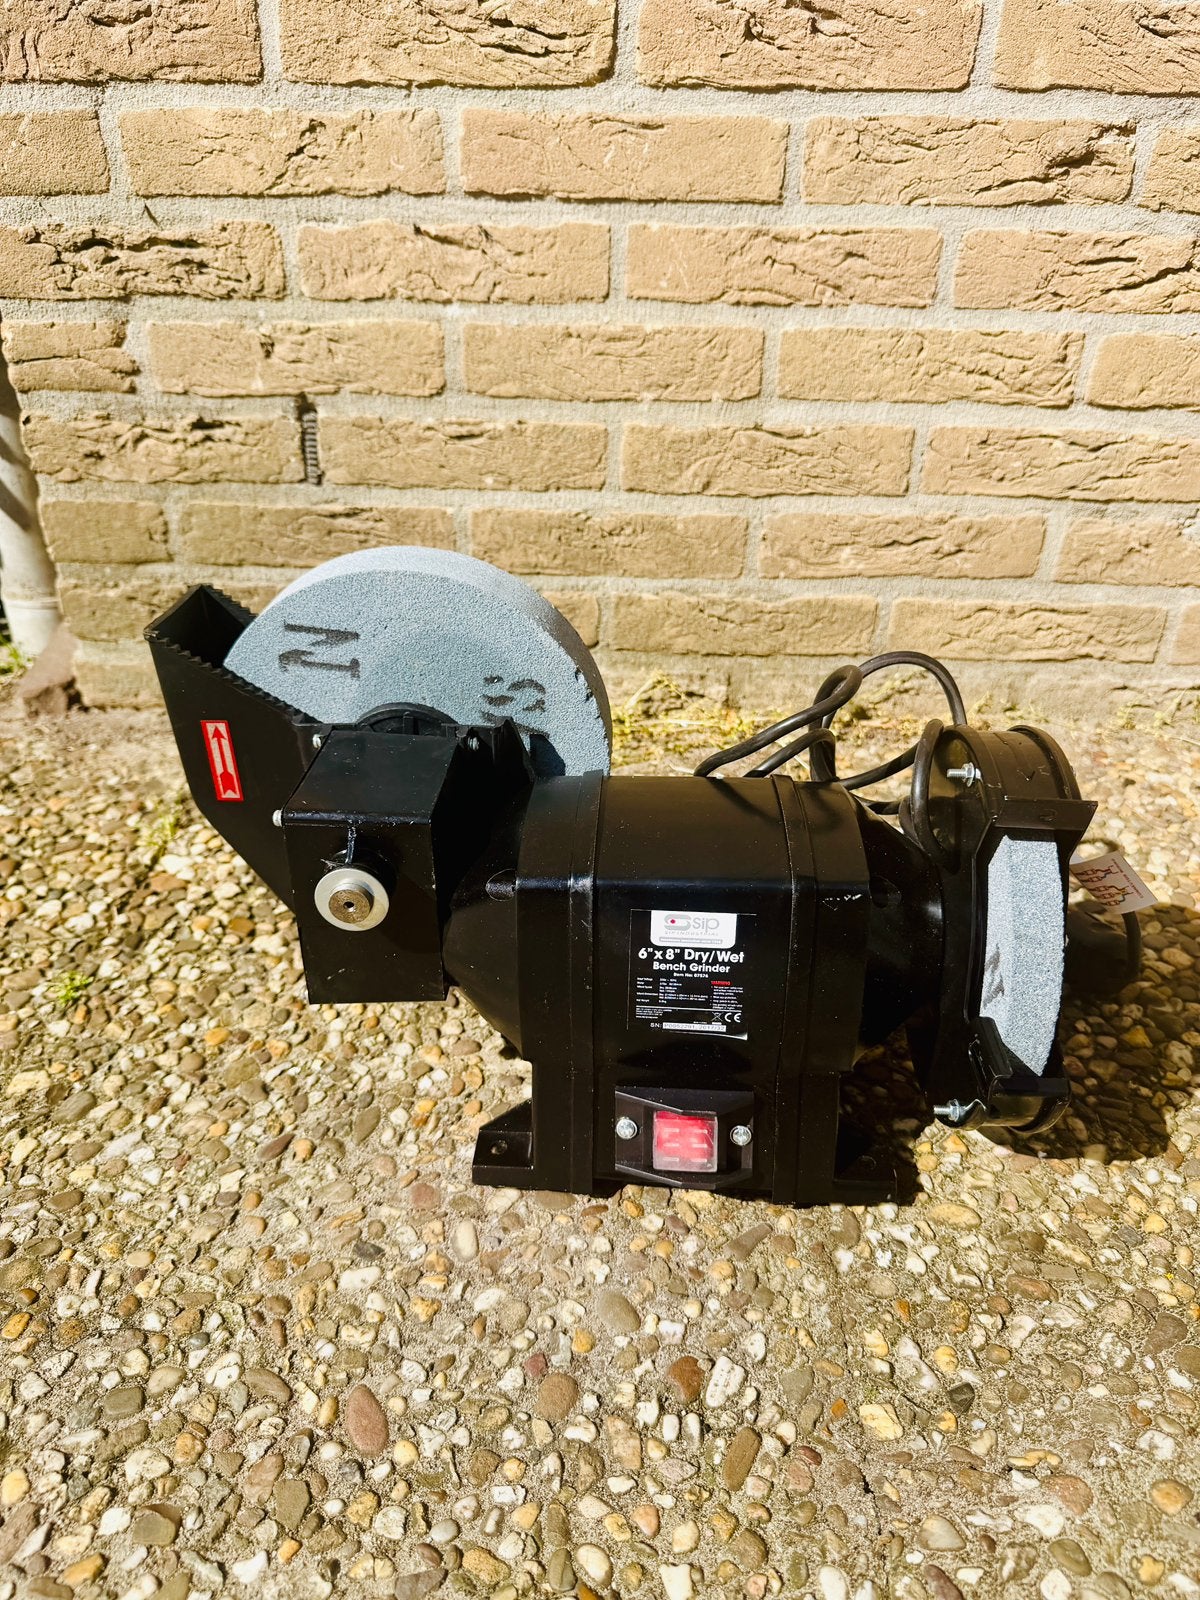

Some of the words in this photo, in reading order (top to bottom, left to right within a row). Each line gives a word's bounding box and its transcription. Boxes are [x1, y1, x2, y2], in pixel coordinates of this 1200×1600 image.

[692, 917, 720, 932] sip
[684, 948, 745, 963] Dry/Wet
[653, 961, 687, 971] Bench
[689, 963, 730, 973] Grinder
